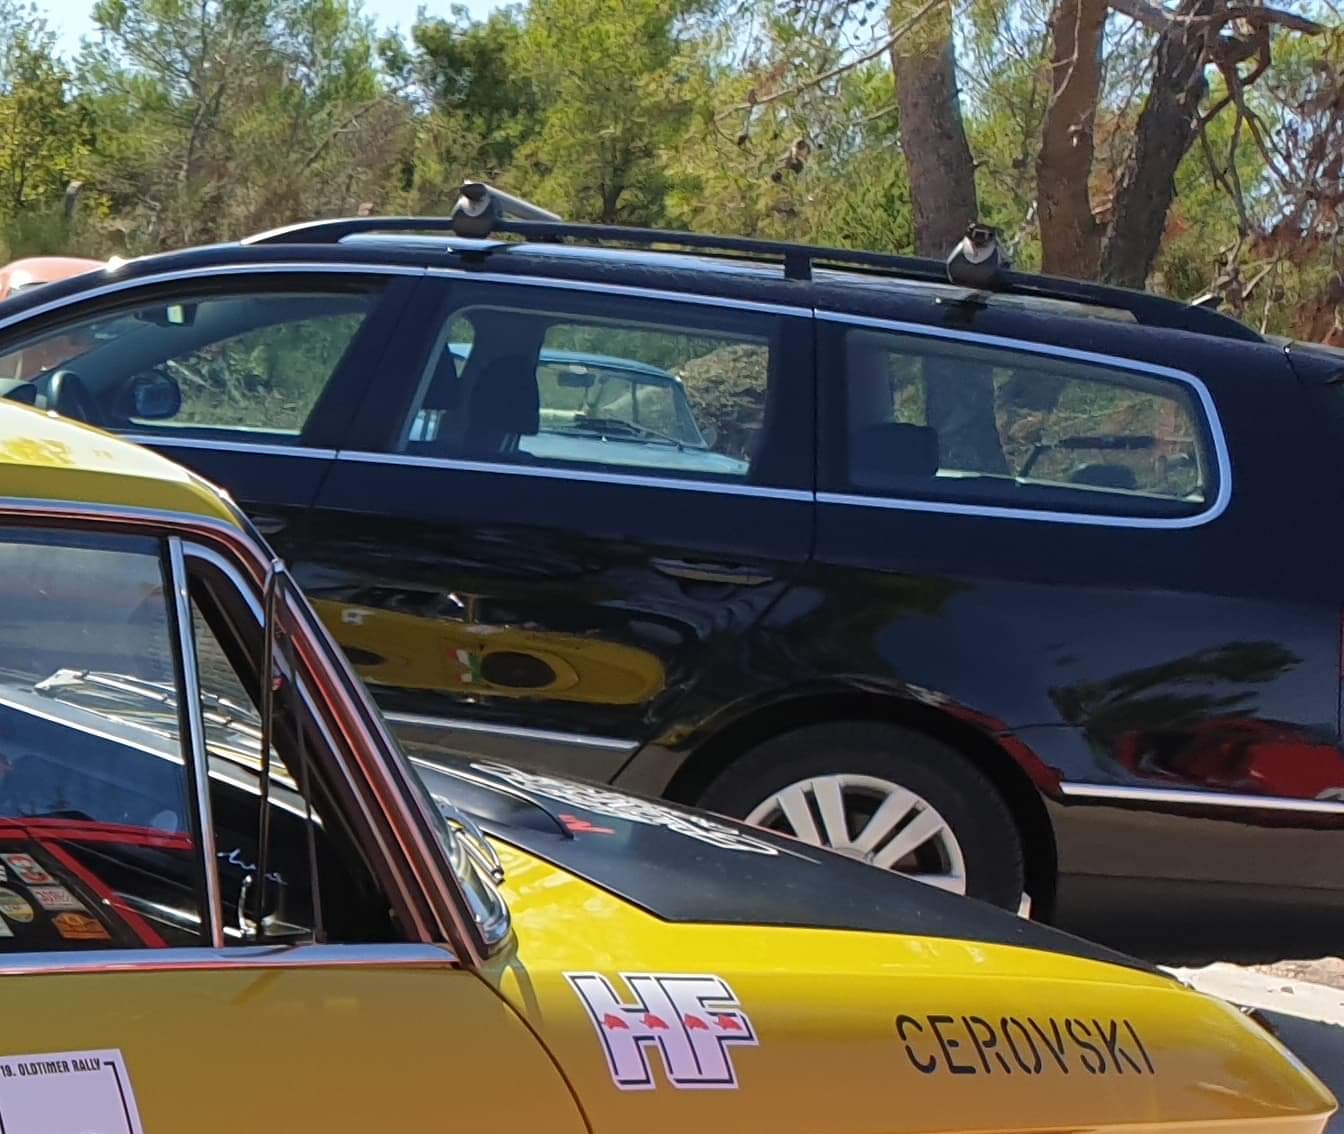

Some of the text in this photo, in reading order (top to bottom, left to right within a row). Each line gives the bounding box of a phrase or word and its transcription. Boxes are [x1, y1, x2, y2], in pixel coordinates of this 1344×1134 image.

[564, 973, 757, 1088] HF
[896, 1014, 1154, 1075] CEROVSKI
[0, 1057, 101, 1077] 19. OLDTIMER RALLY
